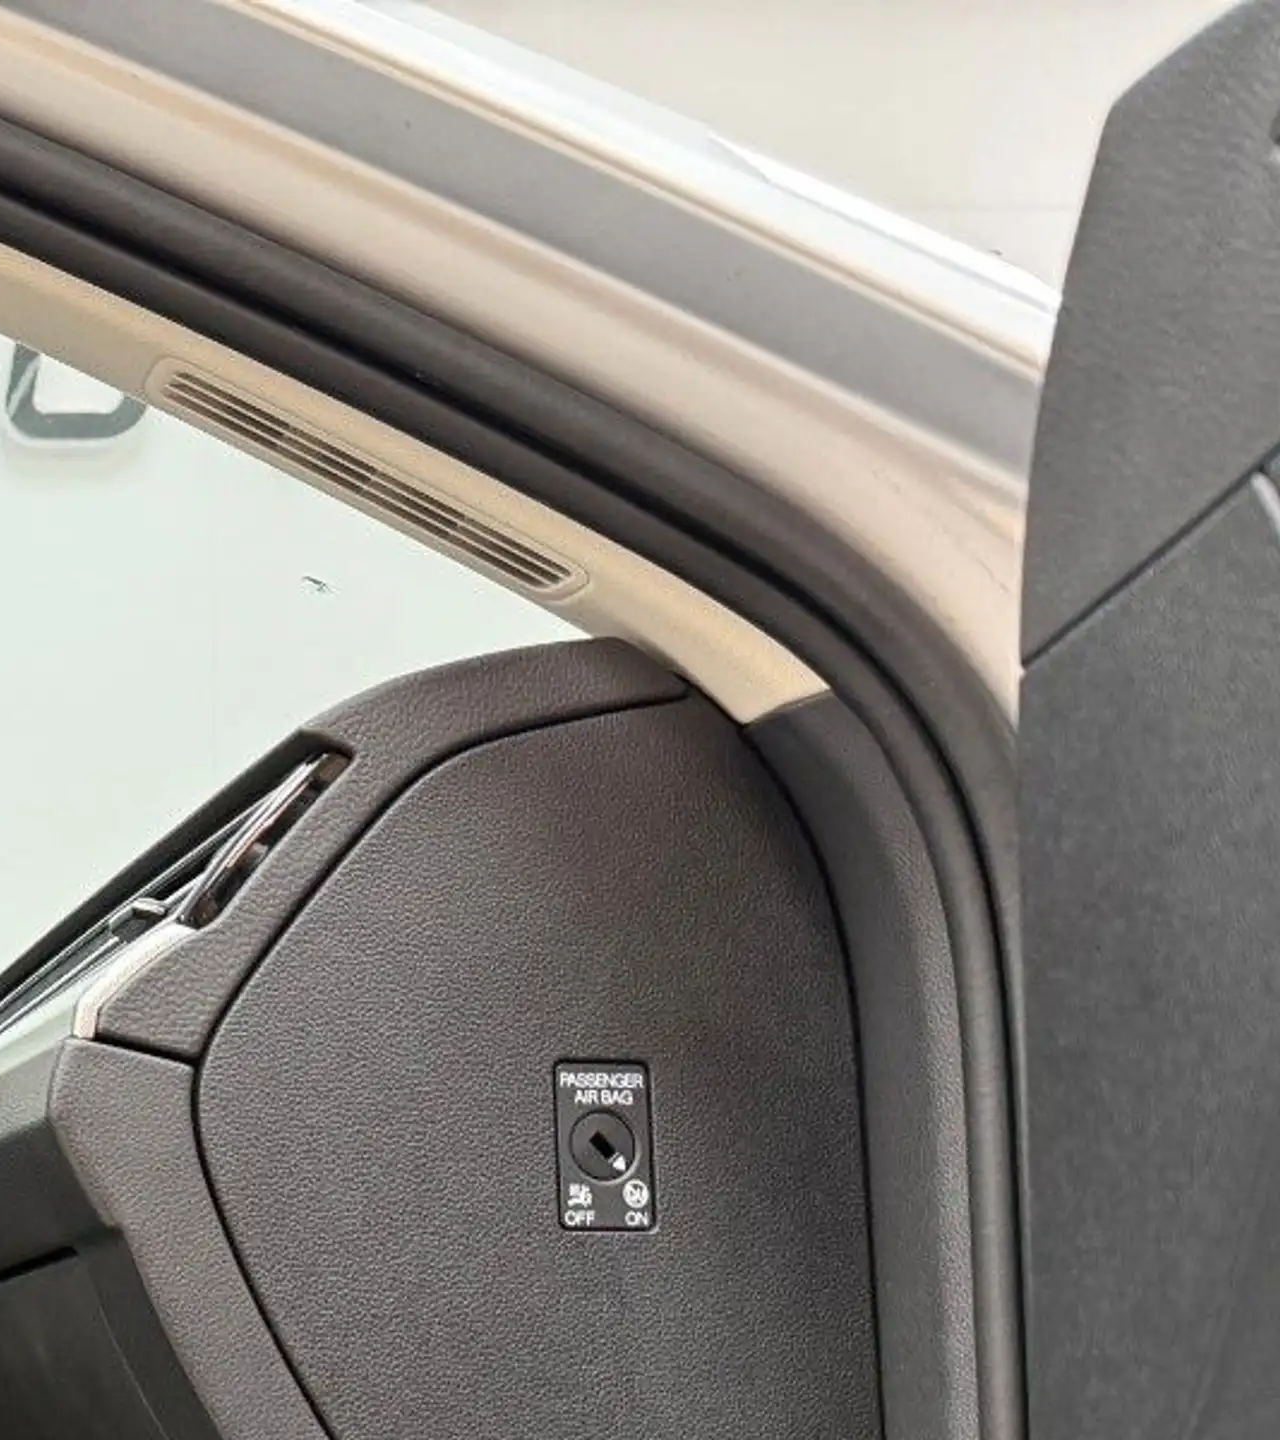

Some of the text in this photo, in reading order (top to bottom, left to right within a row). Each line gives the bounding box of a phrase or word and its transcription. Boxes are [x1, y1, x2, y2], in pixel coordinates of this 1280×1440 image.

[559, 1072, 645, 1089] PASSENGER
[574, 1089, 634, 1105] AIR BAG
[564, 1210, 649, 1227] OFF ON
